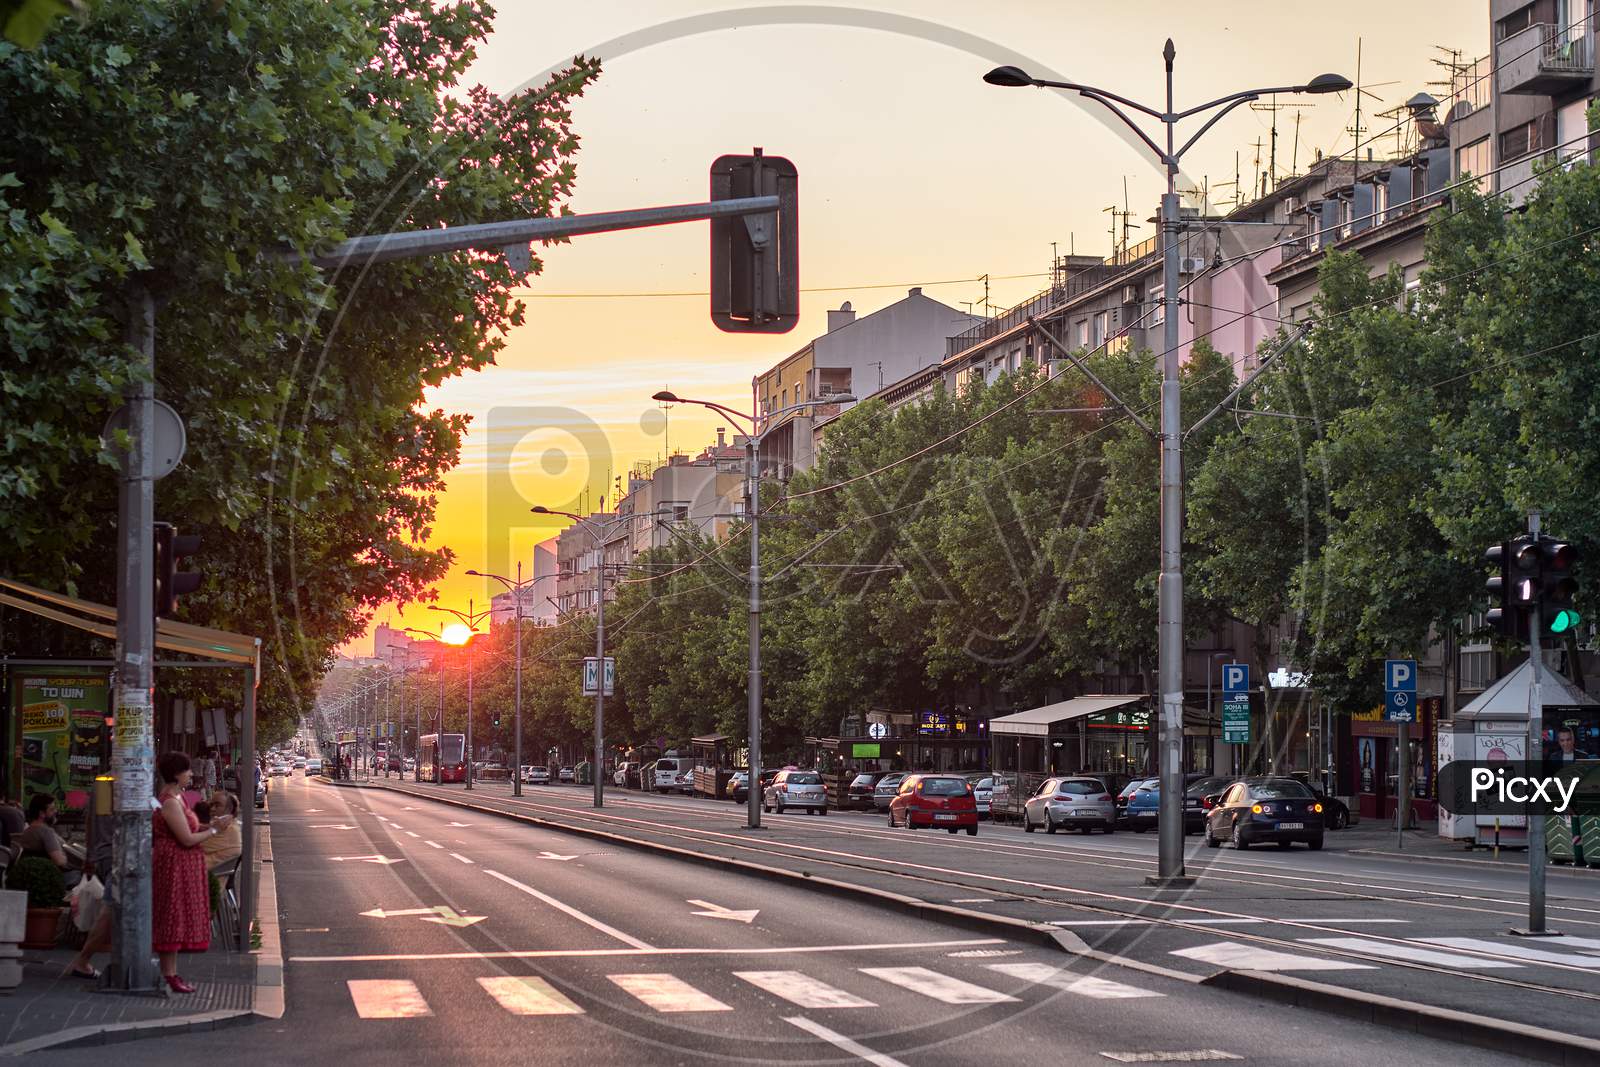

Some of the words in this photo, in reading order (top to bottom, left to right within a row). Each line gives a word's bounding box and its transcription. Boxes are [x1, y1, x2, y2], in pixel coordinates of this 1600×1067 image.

[1228, 667, 1244, 689] P
[1392, 664, 1410, 688] P
[40, 687, 58, 698] TO
[61, 687, 84, 699] WIN
